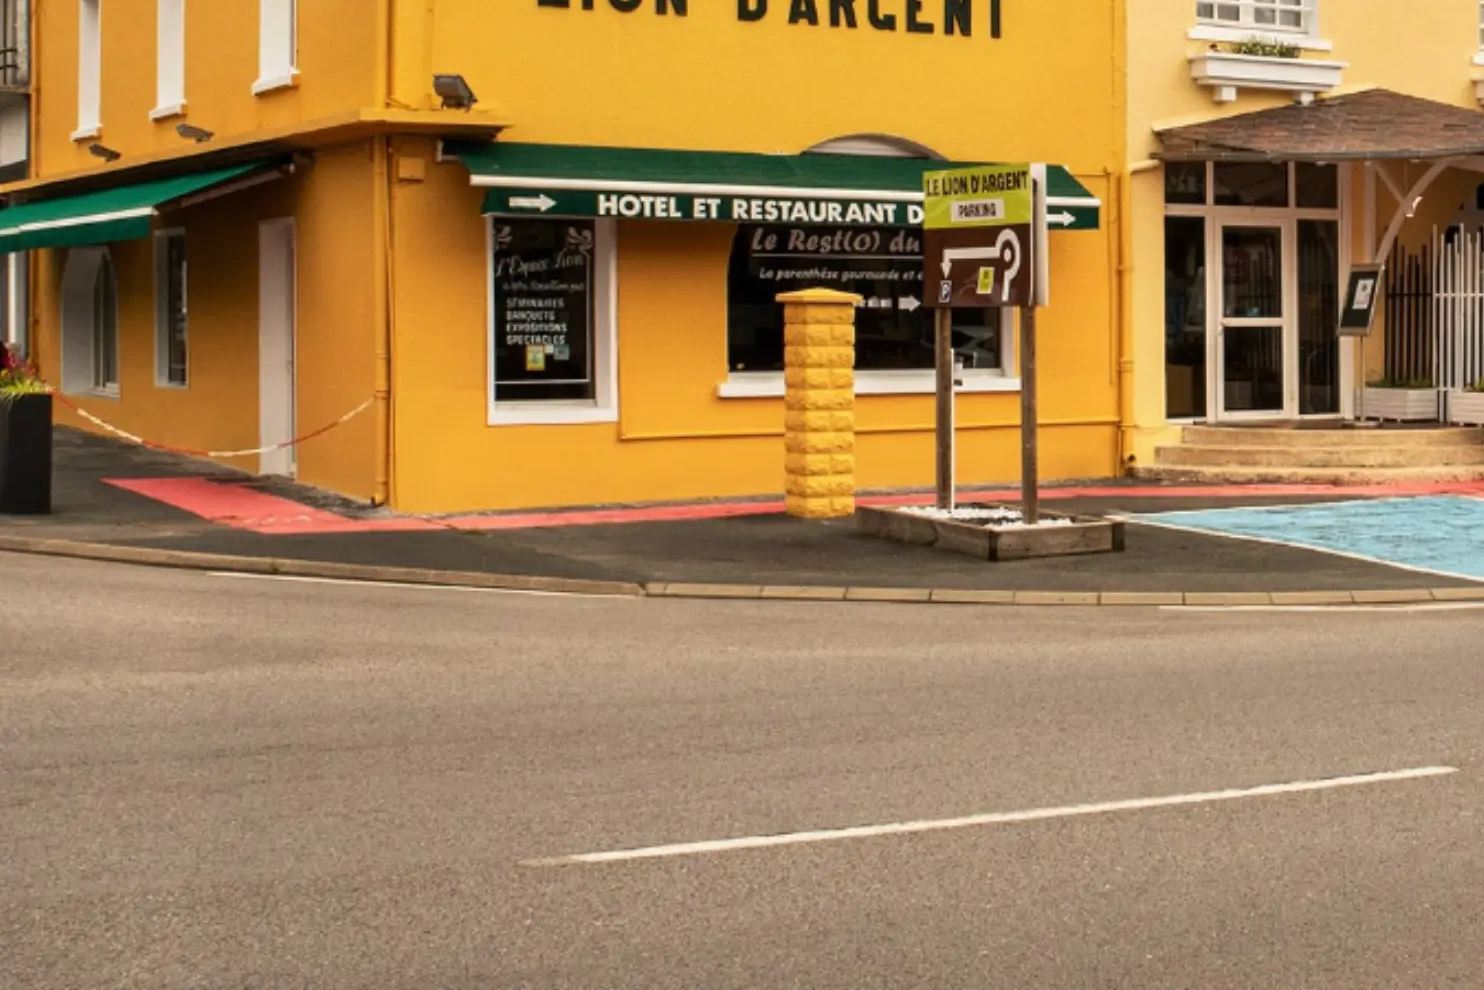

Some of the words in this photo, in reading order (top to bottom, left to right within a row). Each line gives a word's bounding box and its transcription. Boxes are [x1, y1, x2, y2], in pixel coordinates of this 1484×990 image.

[926, 178, 939, 196] LE
[942, 175, 968, 195] LION
[970, 170, 1028, 193] D'ARGENT
[597, 194, 681, 217] HOTEL
[692, 198, 721, 219] ET
[732, 199, 897, 223] RESTAURANT
[907, 205, 924, 224] D
[958, 203, 996, 217] PARKING
[752, 228, 778, 251] Le
[889, 230, 920, 252] du
[759, 267, 772, 279] La
